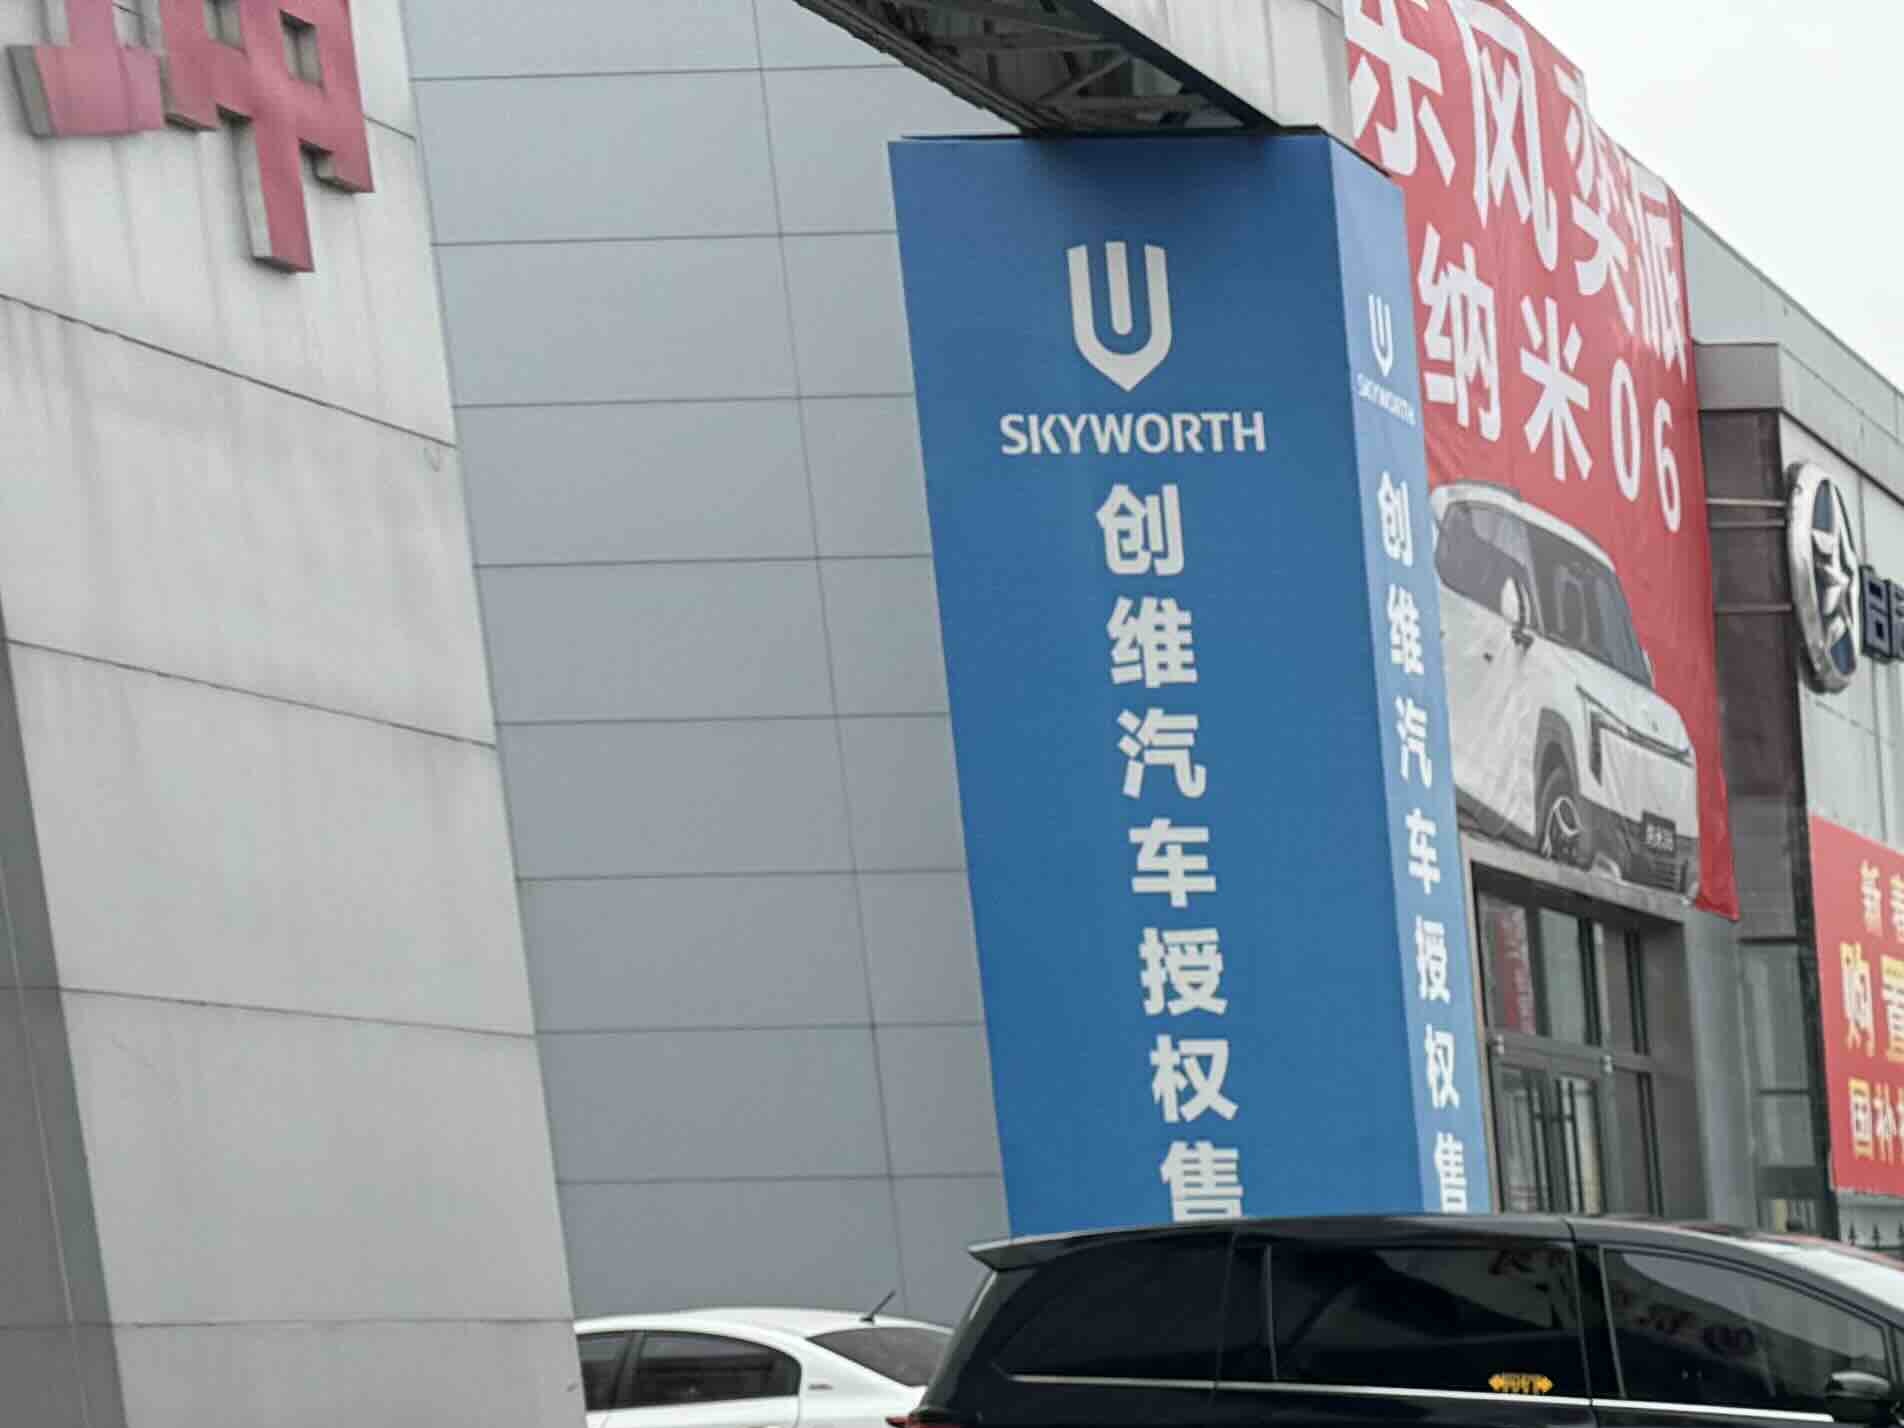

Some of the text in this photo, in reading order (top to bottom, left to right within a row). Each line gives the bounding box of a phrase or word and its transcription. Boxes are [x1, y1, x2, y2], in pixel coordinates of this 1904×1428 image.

[1000, 411, 1267, 456] SKYWORTH
[1415, 222, 1684, 533] 纳米06
[1096, 484, 1243, 1222] 创维汽车授权售
